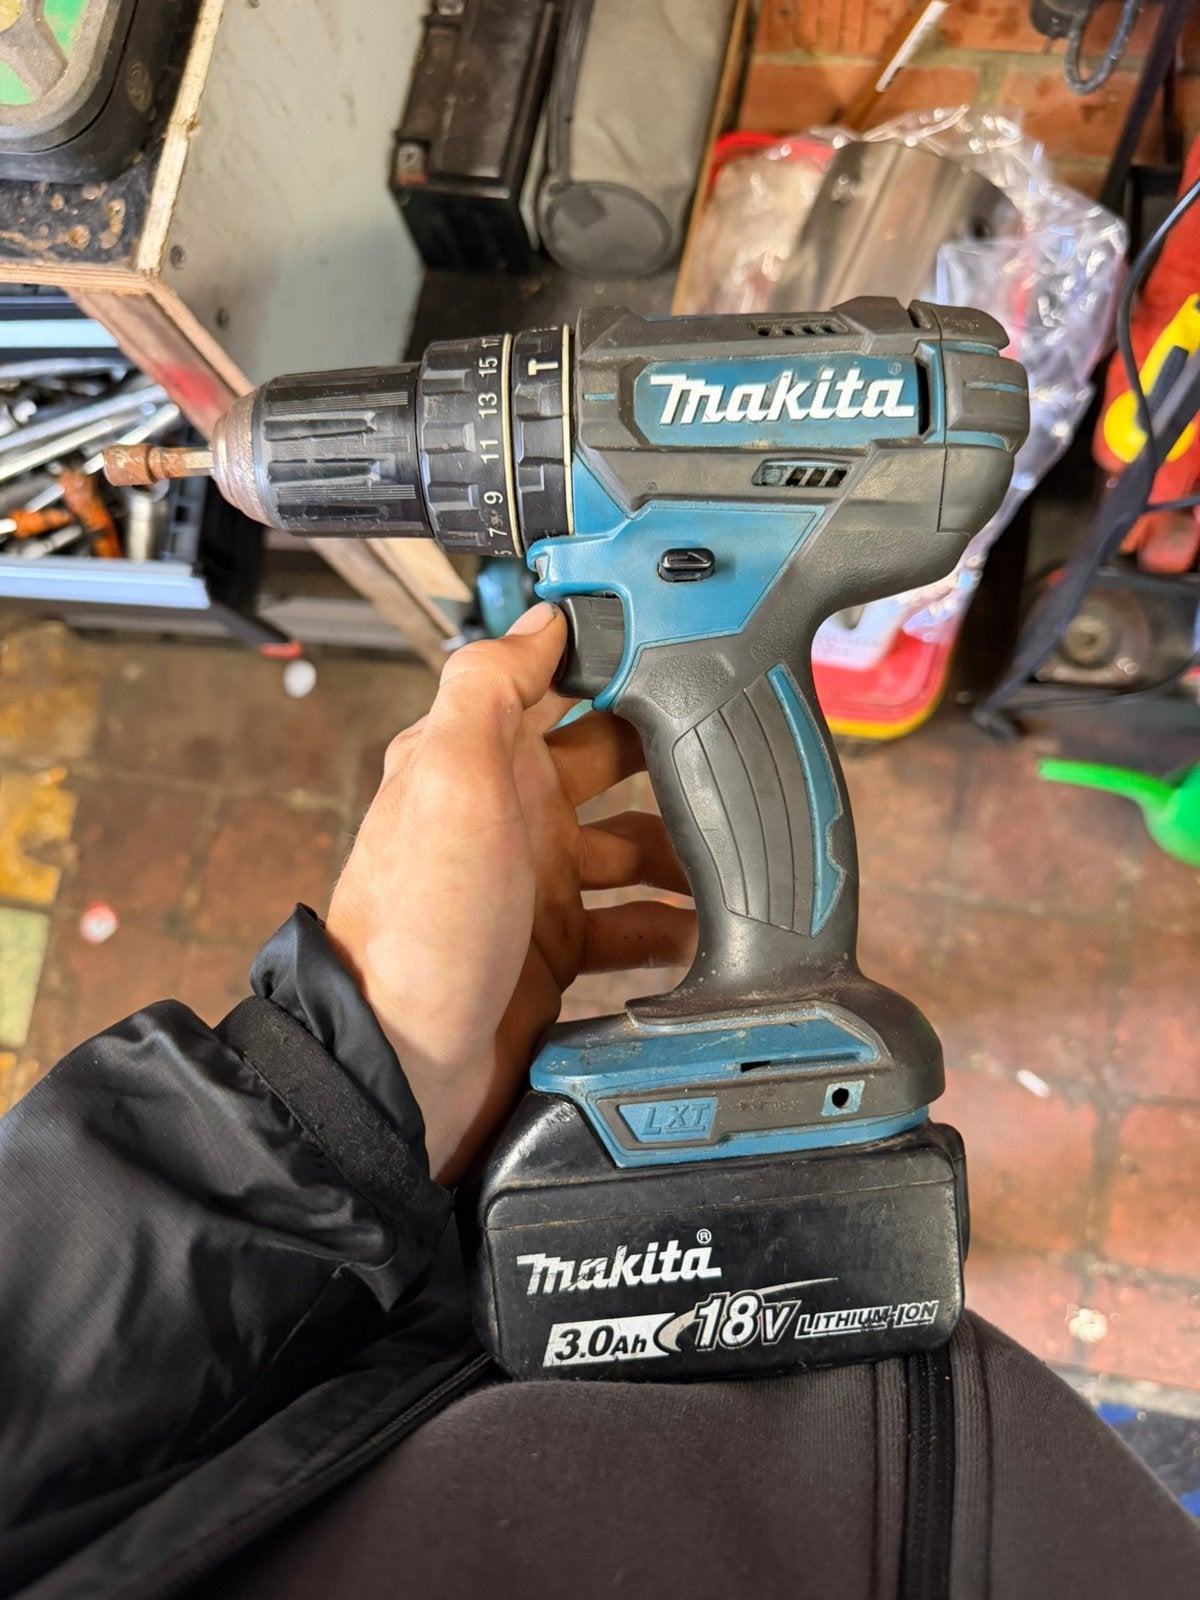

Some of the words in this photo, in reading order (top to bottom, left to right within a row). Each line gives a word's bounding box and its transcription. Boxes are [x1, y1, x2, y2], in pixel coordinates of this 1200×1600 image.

[478, 356, 498, 378] 15
[478, 392, 498, 419] 13
[480, 438, 499, 464] 11
[483, 491, 504, 505] 9
[487, 527, 508, 537] 7
[640, 1103, 710, 1136] LXT
[553, 1328, 648, 1362] 3.0Ah
[794, 1300, 940, 1340] LITHIUM-ION
